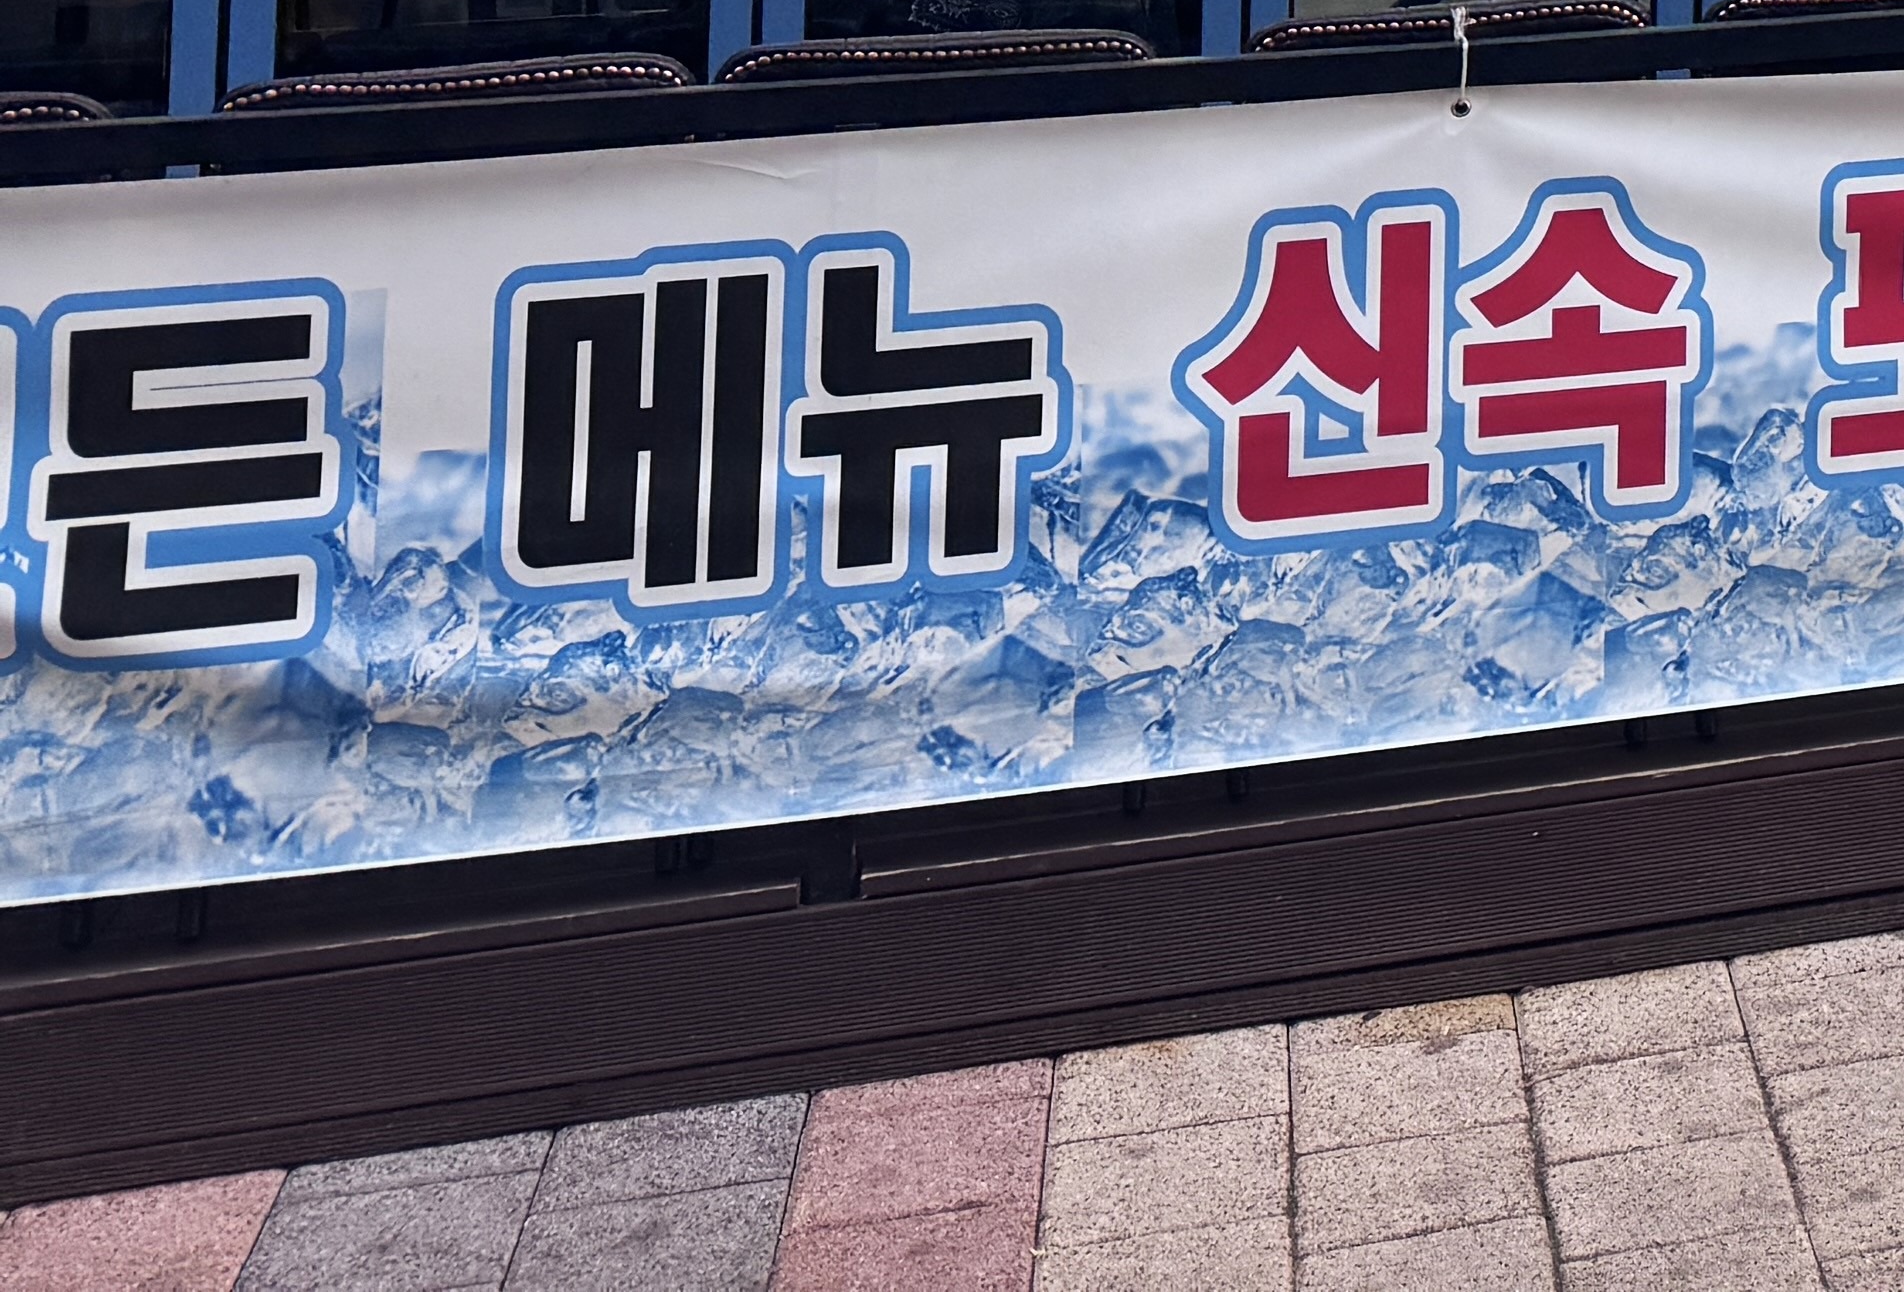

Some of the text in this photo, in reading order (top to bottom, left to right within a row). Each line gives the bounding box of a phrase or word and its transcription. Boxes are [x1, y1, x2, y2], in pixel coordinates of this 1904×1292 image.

[45, 313, 325, 644] 든
[516, 263, 1048, 597] 메뉴
[1200, 206, 1690, 526] 신속
